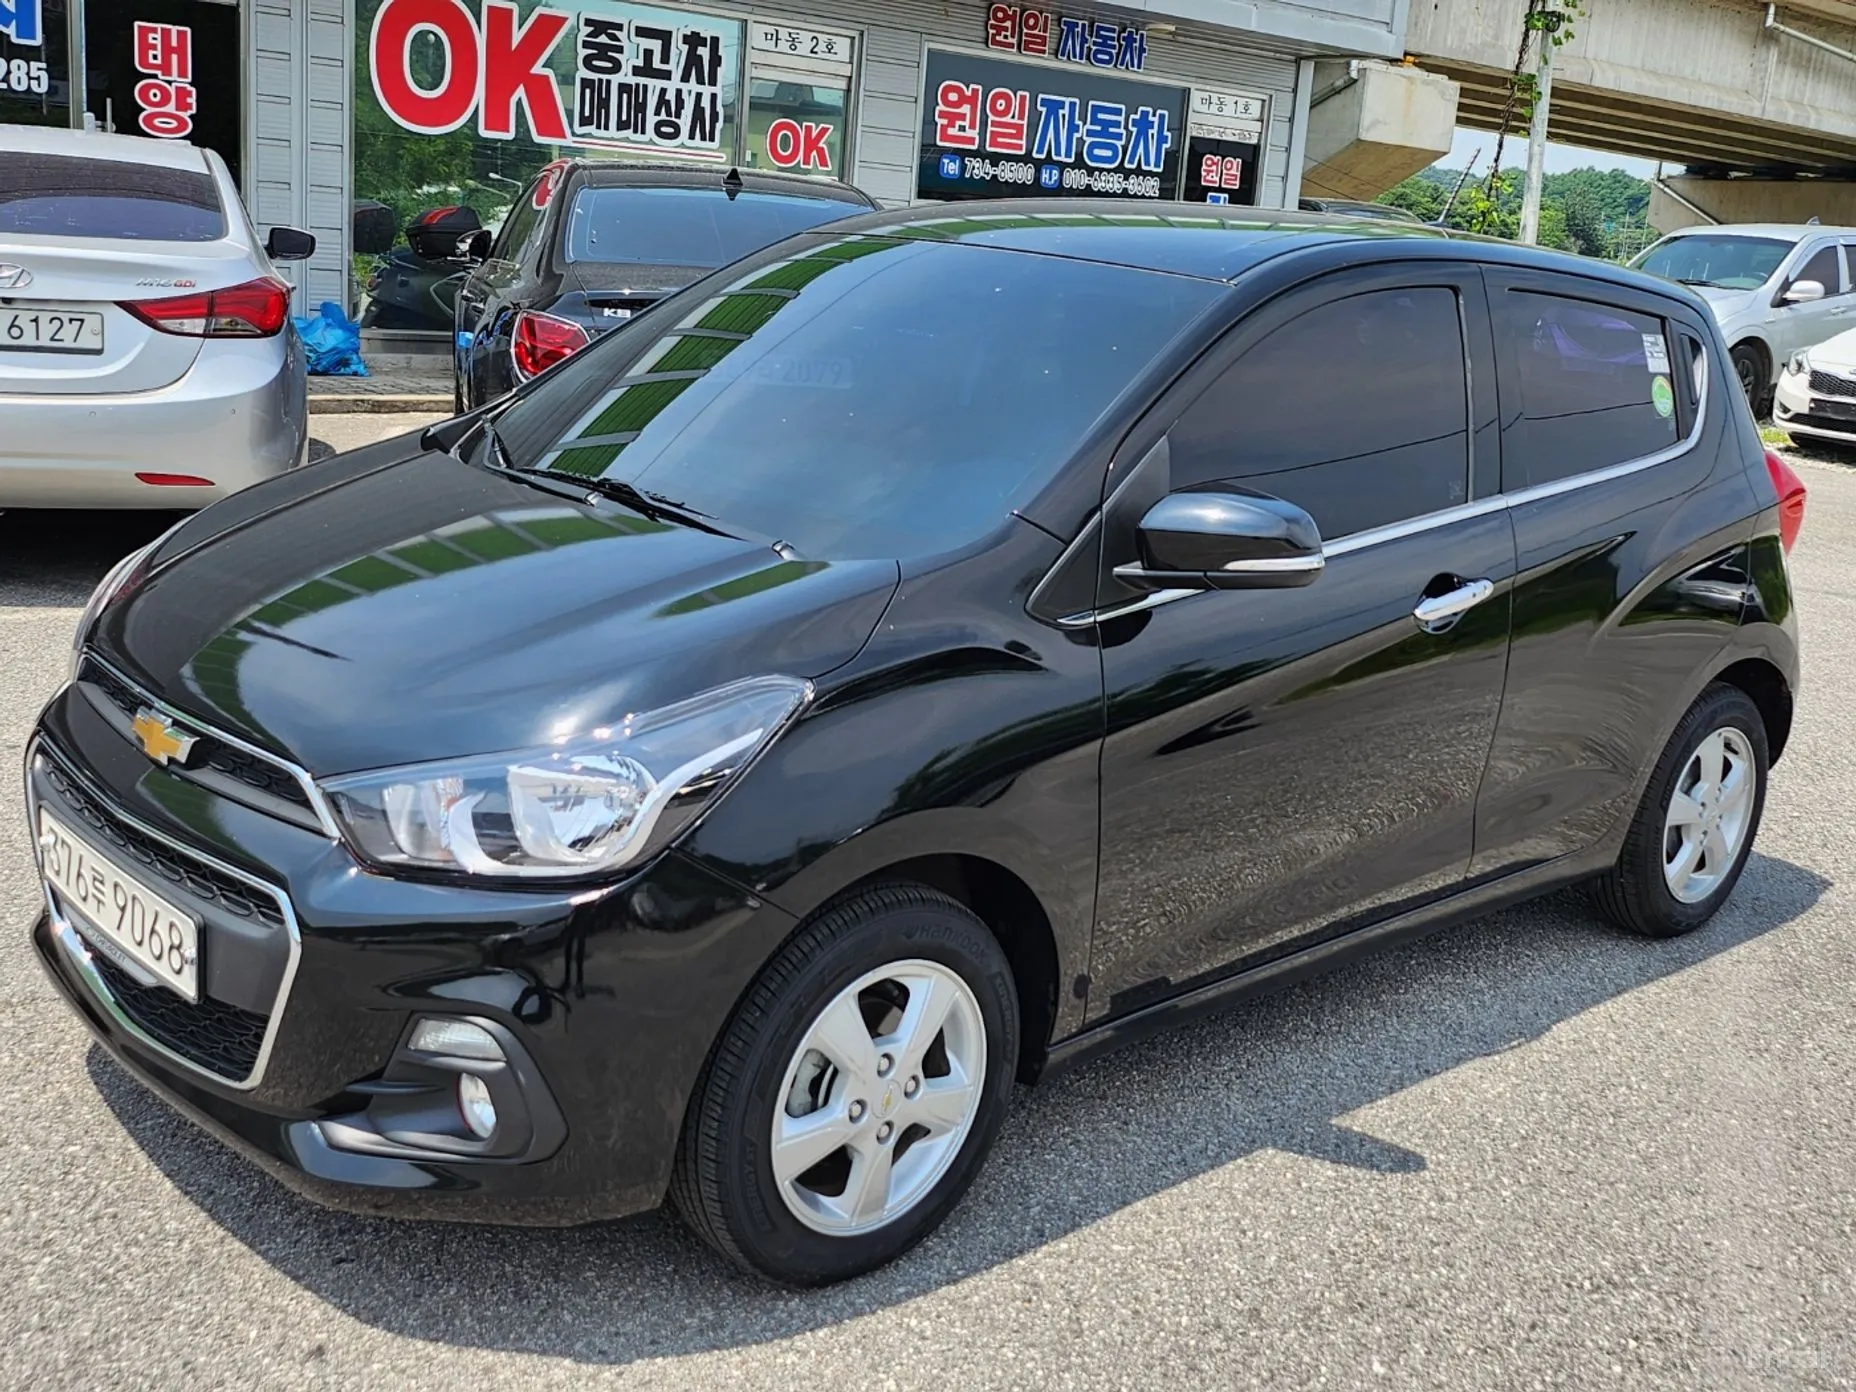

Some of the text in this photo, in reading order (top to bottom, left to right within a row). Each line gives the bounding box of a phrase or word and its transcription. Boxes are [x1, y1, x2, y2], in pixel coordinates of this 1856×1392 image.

[582, 17, 723, 87] 중고차
[763, 28, 838, 55] 마동 2호
[987, 3, 1148, 71] 원일 자동차
[134, 21, 196, 137] 태양
[369, 0, 572, 144] OK
[1200, 94, 1228, 113] 마동
[578, 76, 720, 143] 매매상사
[935, 80, 1171, 173] 원일 자동차
[767, 118, 833, 171] OK
[943, 158, 960, 176] Tel
[964, 158, 1035, 185] 734-8500
[1201, 154, 1242, 189] 원일
[7, 314, 86, 343] 6127
[113, 880, 184, 975] 9068
